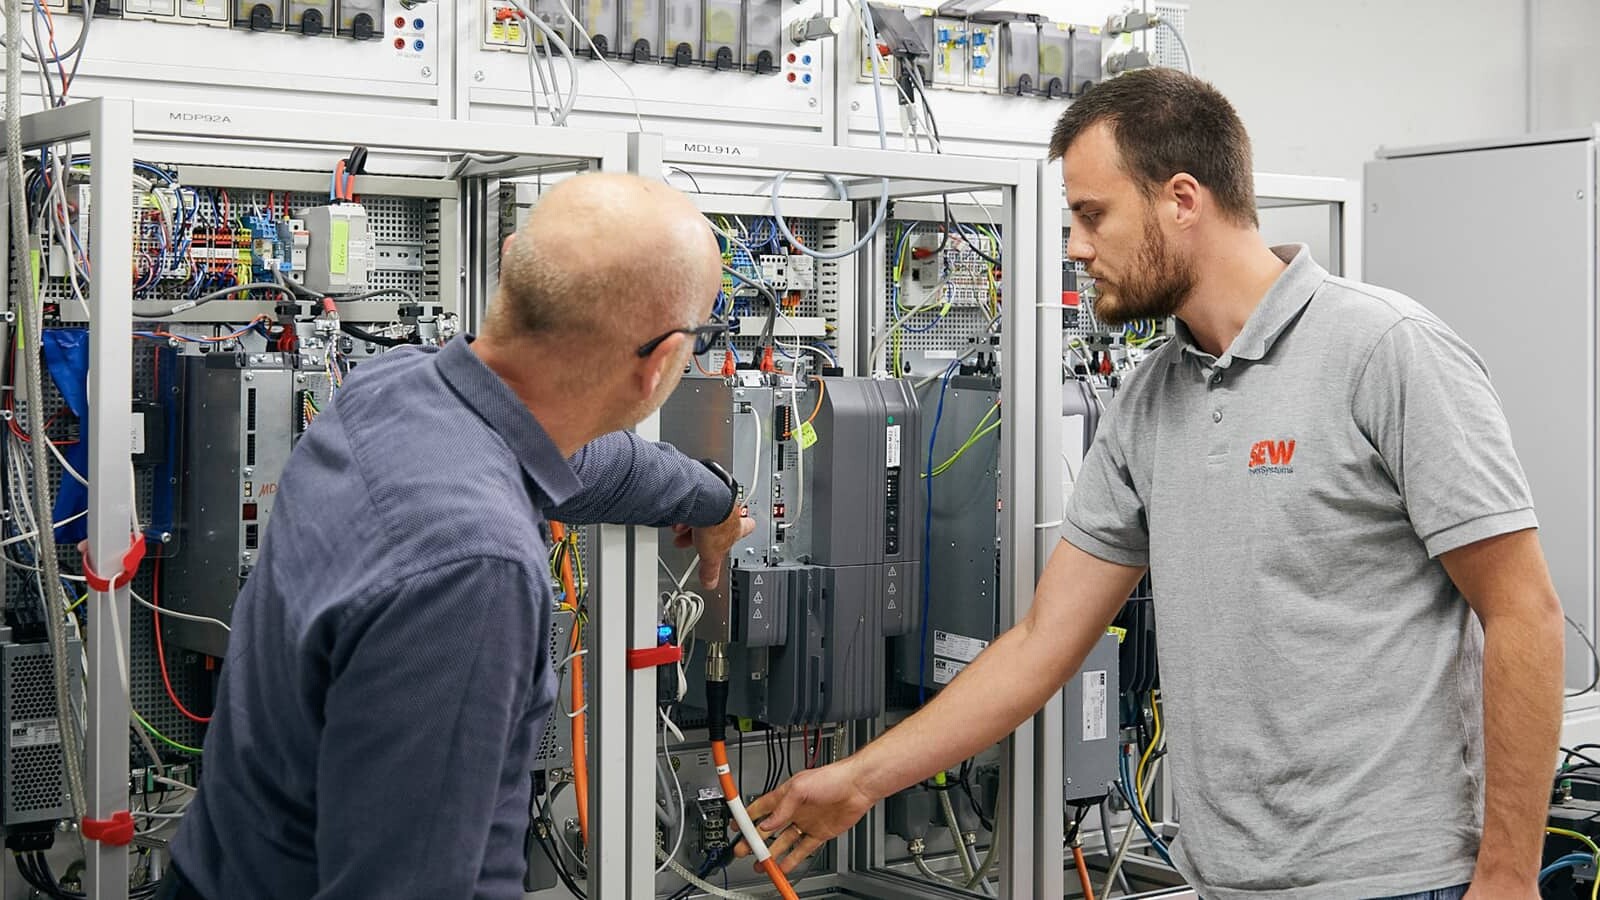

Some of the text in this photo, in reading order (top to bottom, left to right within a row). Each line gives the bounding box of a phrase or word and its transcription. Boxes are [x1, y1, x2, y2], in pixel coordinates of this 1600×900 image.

[169, 112, 231, 123] MDP92A
[684, 143, 741, 155] MDL91A
[1248, 439, 1296, 468] SEW
